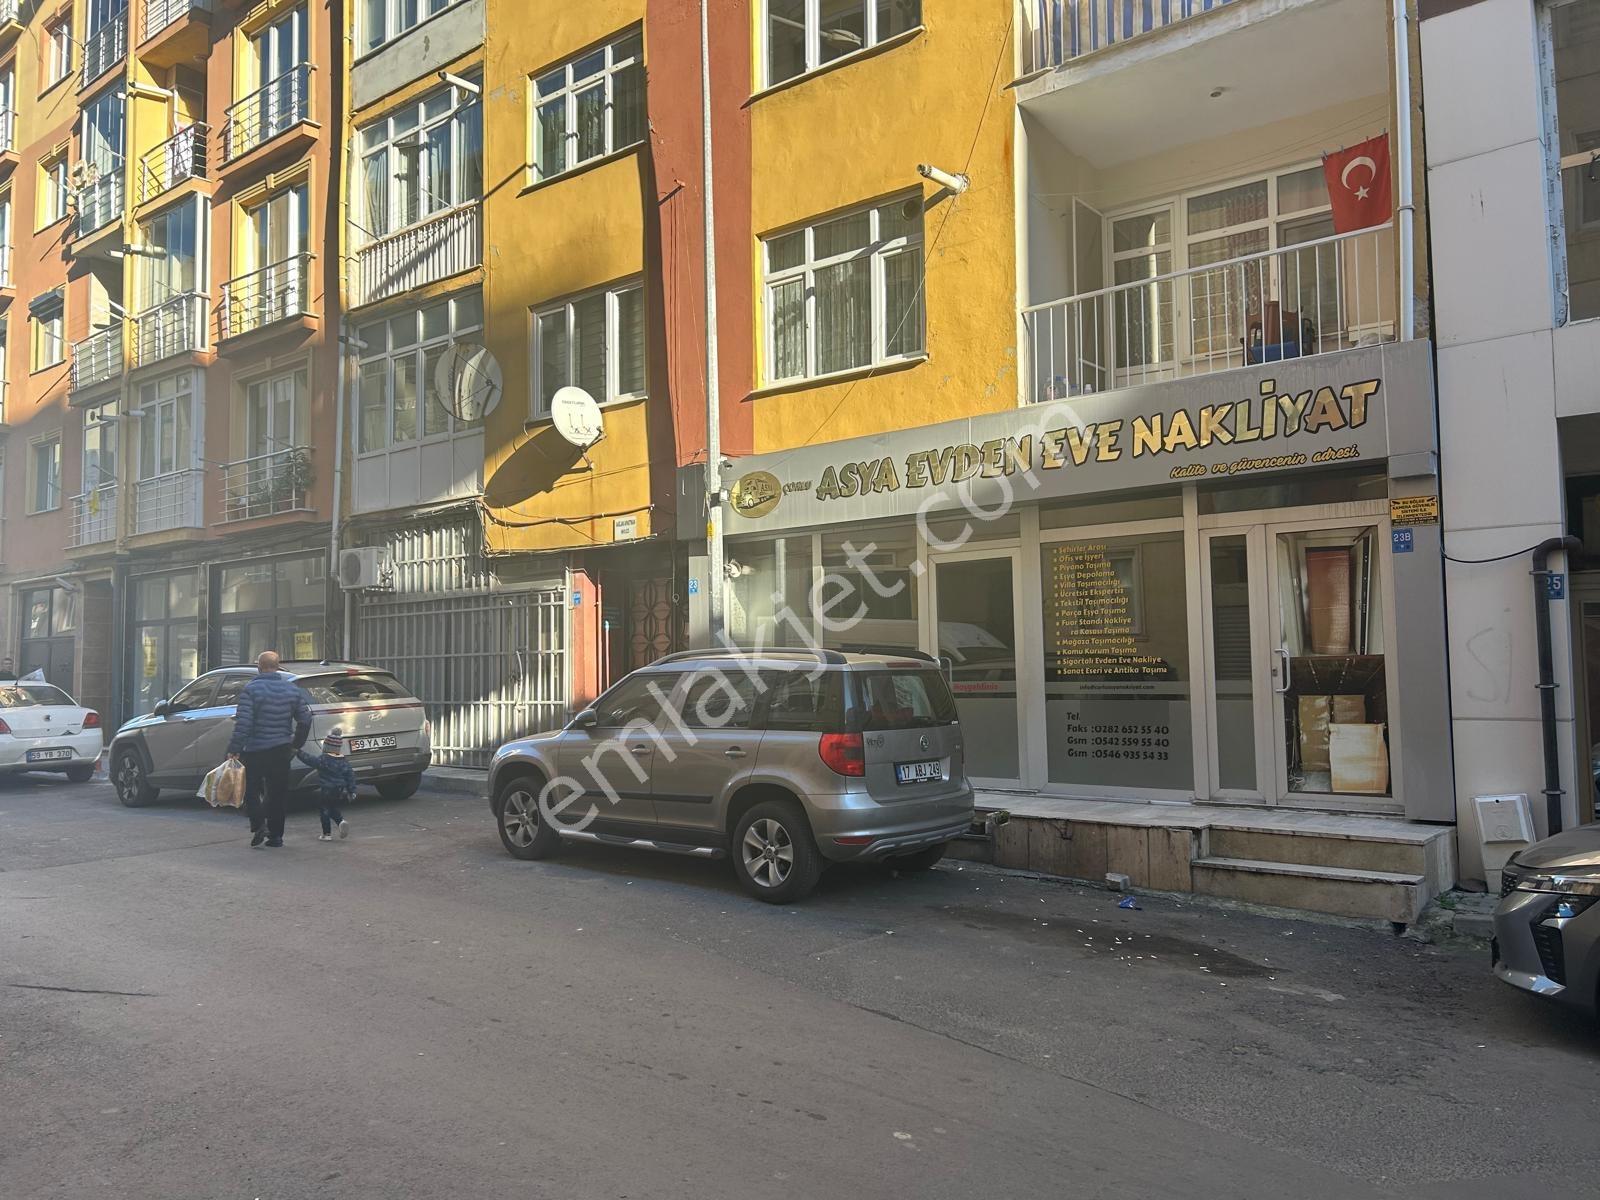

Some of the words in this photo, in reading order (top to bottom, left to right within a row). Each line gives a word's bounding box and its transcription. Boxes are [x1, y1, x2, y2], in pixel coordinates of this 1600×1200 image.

[816, 457, 900, 501] ASYA
[906, 434, 1032, 488] EVDEN
[1040, 420, 1123, 470] EVE
[1131, 379, 1381, 459] NAKLİYAT
[1170, 463, 1207, 479] Kalite
[1211, 463, 1228, 474] ve
[1228, 453, 1306, 474] güvencenin
[1393, 533, 1411, 542] 23B
[1104, 616, 1132, 625] Nakliye
[1111, 646, 1137, 655] Taşıma
[1063, 658, 1094, 666] Sigortalı
[1132, 655, 1162, 664] Nakliye
[1063, 667, 1084, 675] Sanat
[1085, 666, 1102, 674] Eseri
[1113, 666, 1139, 674] Antika
[1142, 666, 1167, 675] Taşıma
[1067, 724, 1087, 733] Faks
[1121, 725, 1138, 733] 652
[1141, 726, 1152, 734] 55
[1154, 726, 1169, 734] 40
[354, 740, 365, 749] 59
[367, 738, 379, 747] YA
[1067, 736, 1087, 745] Gsm
[1121, 737, 1139, 746] 559
[1141, 738, 1152, 746] 55
[1154, 738, 1169, 747] 40
[1068, 748, 1087, 757] Gsm
[1123, 750, 1140, 759] 935
[1143, 751, 1155, 760] 54
[1157, 752, 1168, 760] 33
[902, 765, 910, 778] 17
[914, 763, 926, 777] ABJ
